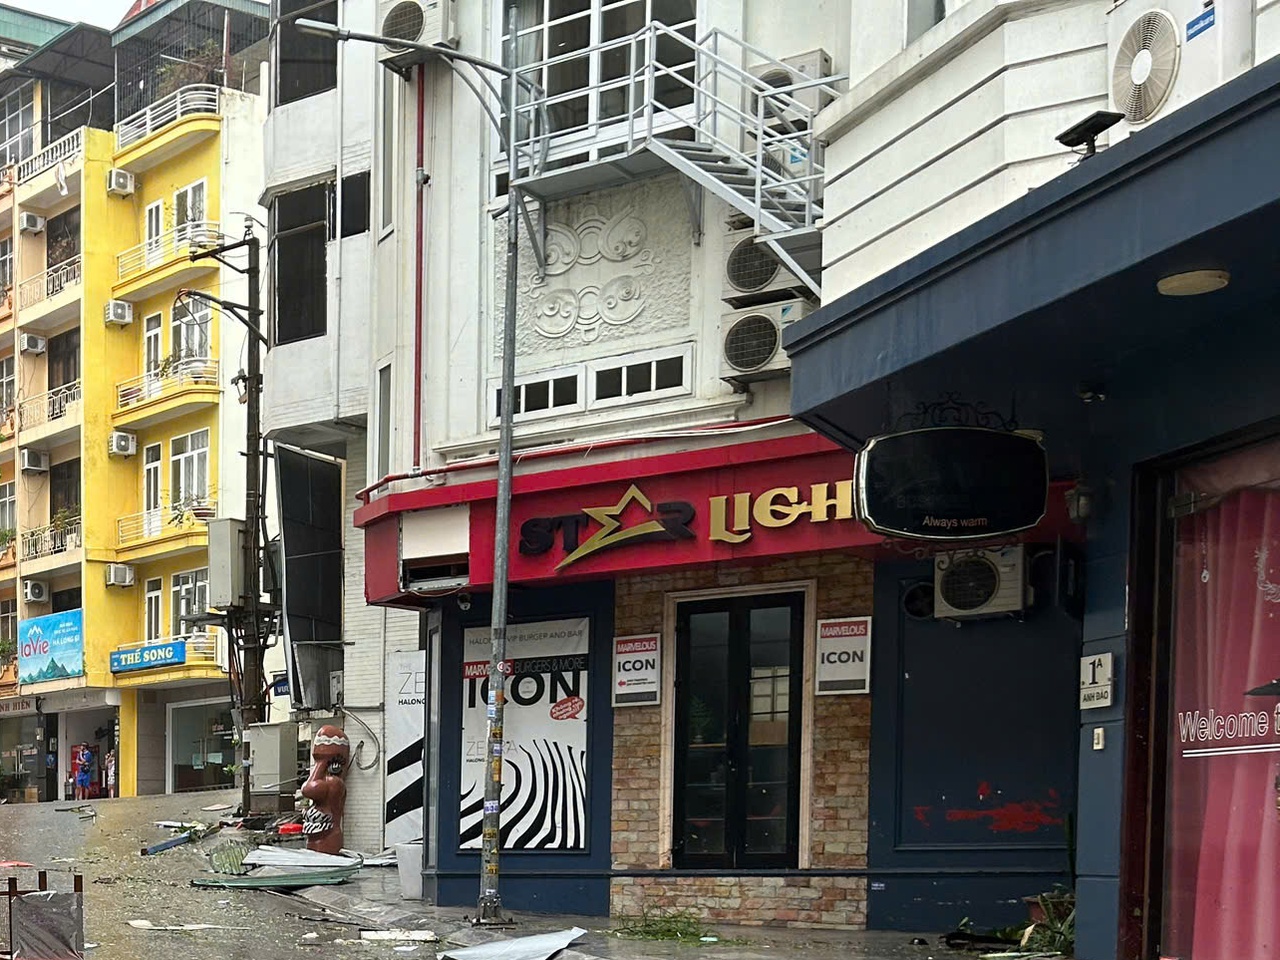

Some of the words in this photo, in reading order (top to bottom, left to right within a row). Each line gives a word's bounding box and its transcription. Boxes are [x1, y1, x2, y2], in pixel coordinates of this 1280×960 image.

[709, 480, 853, 543] LIGH
[922, 516, 959, 529] Always
[960, 517, 988, 527] warm
[519, 632, 549, 642] BURGER
[550, 631, 566, 639] AND
[567, 629, 583, 638] BAR
[821, 625, 866, 637] MARVELOUS
[617, 641, 656, 653] MARVELOUS
[143, 647, 174, 662] SONG
[821, 650, 864, 664] ICON
[514, 659, 551, 674] BURGERS
[559, 656, 585, 670] MORE
[618, 658, 656, 673] ICON
[1178, 709, 1270, 743] Welcome
